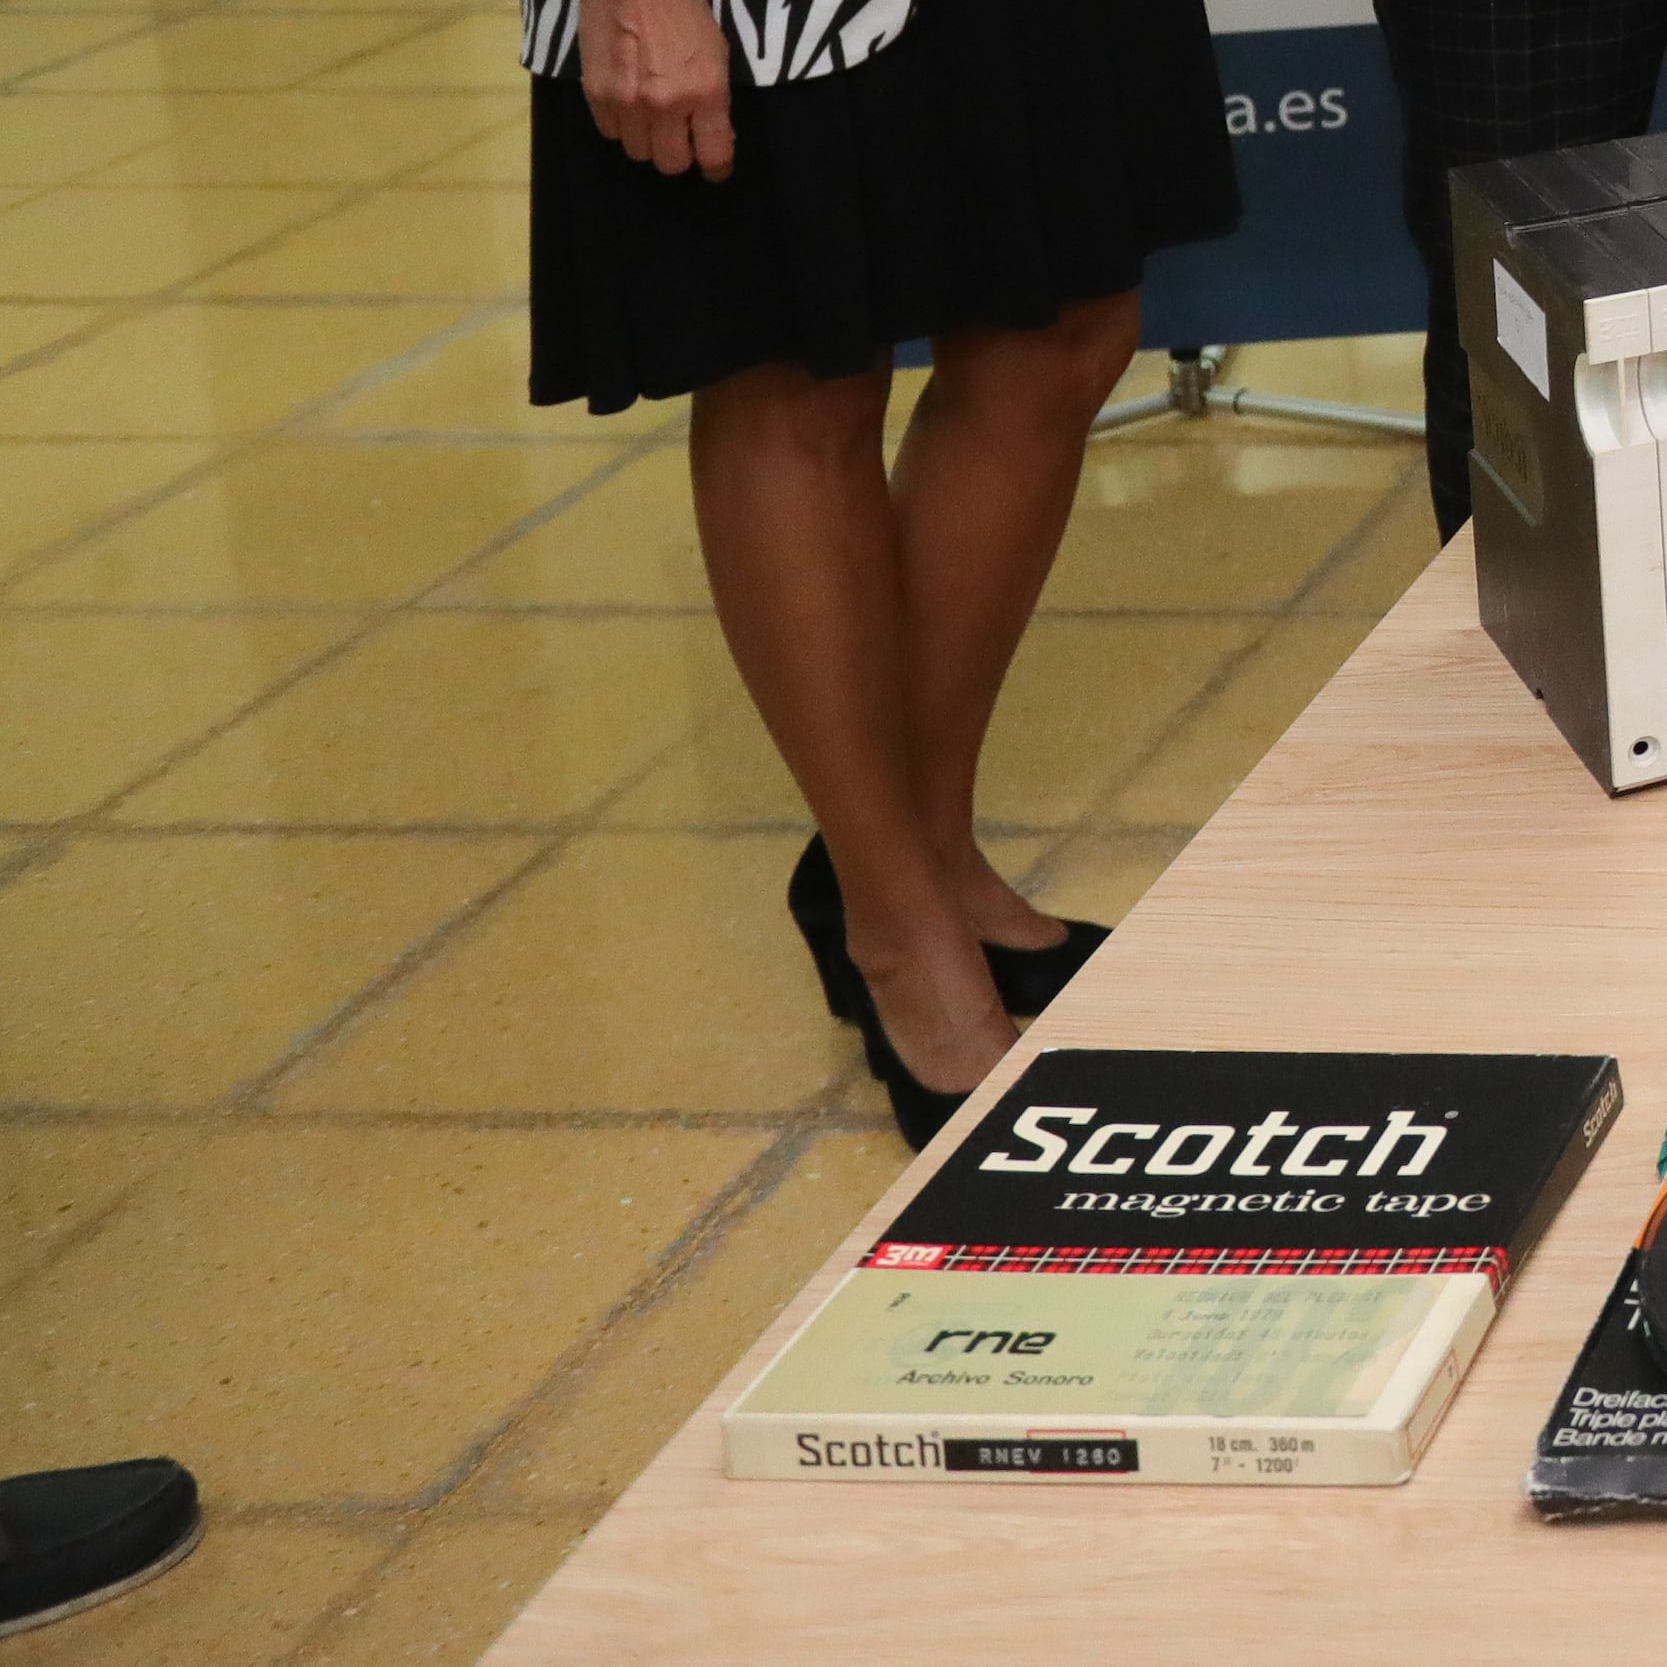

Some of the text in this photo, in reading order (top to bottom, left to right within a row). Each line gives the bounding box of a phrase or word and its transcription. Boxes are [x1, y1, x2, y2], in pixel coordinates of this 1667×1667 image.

[1583, 1079, 1617, 1148] Scotch
[977, 1106, 1451, 1177] Scotch
[1052, 1188, 1492, 1220] magnetic tape
[924, 1329, 1057, 1355] rne
[896, 1369, 991, 1385] Archivo
[1003, 1370, 1095, 1385] Sonoro
[1569, 1407, 1637, 1432] Triple
[797, 1433, 943, 1468] Scotch
[1207, 1436, 1226, 1451] 18
[1552, 1428, 1648, 1448] Bande
[978, 1447, 1042, 1465] RNEV
